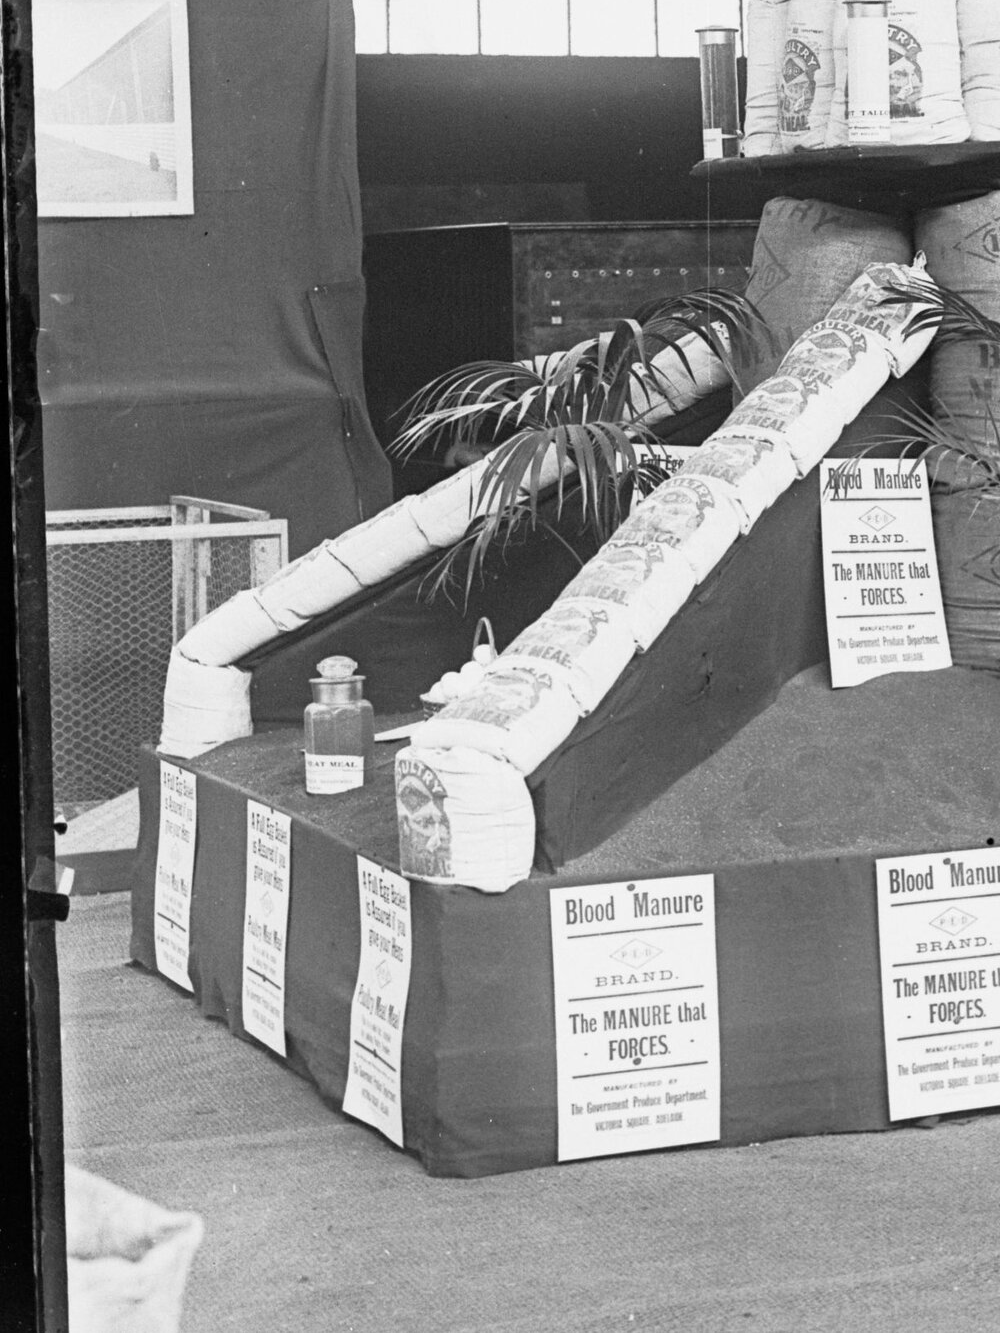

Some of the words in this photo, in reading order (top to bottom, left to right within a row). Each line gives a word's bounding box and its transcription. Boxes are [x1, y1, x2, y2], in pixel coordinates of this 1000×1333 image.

[828, 467, 862, 490] Blood
[874, 467, 922, 490] Manure
[849, 534, 909, 544] BRAND.
[832, 563, 852, 581] The
[856, 562, 906, 581] MANURE
[909, 562, 931, 580] that
[861, 588, 907, 606] FORCES.
[849, 637, 881, 648] Government
[889, 866, 934, 894] Blood
[566, 895, 615, 925] Blood
[633, 892, 703, 919] Manure
[916, 936, 993, 954] BRAND.
[595, 969, 680, 987] BRAND.
[893, 977, 919, 999] The
[924, 969, 987, 995] MANURE
[569, 1013, 598, 1035] The
[604, 1004, 672, 1031] MANURE
[678, 1002, 706, 1023] that
[929, 998, 987, 1024] FORCES.
[608, 1035, 671, 1061] FORCES.
[911, 1059, 950, 1075] Government
[586, 1097, 629, 1115] Government
